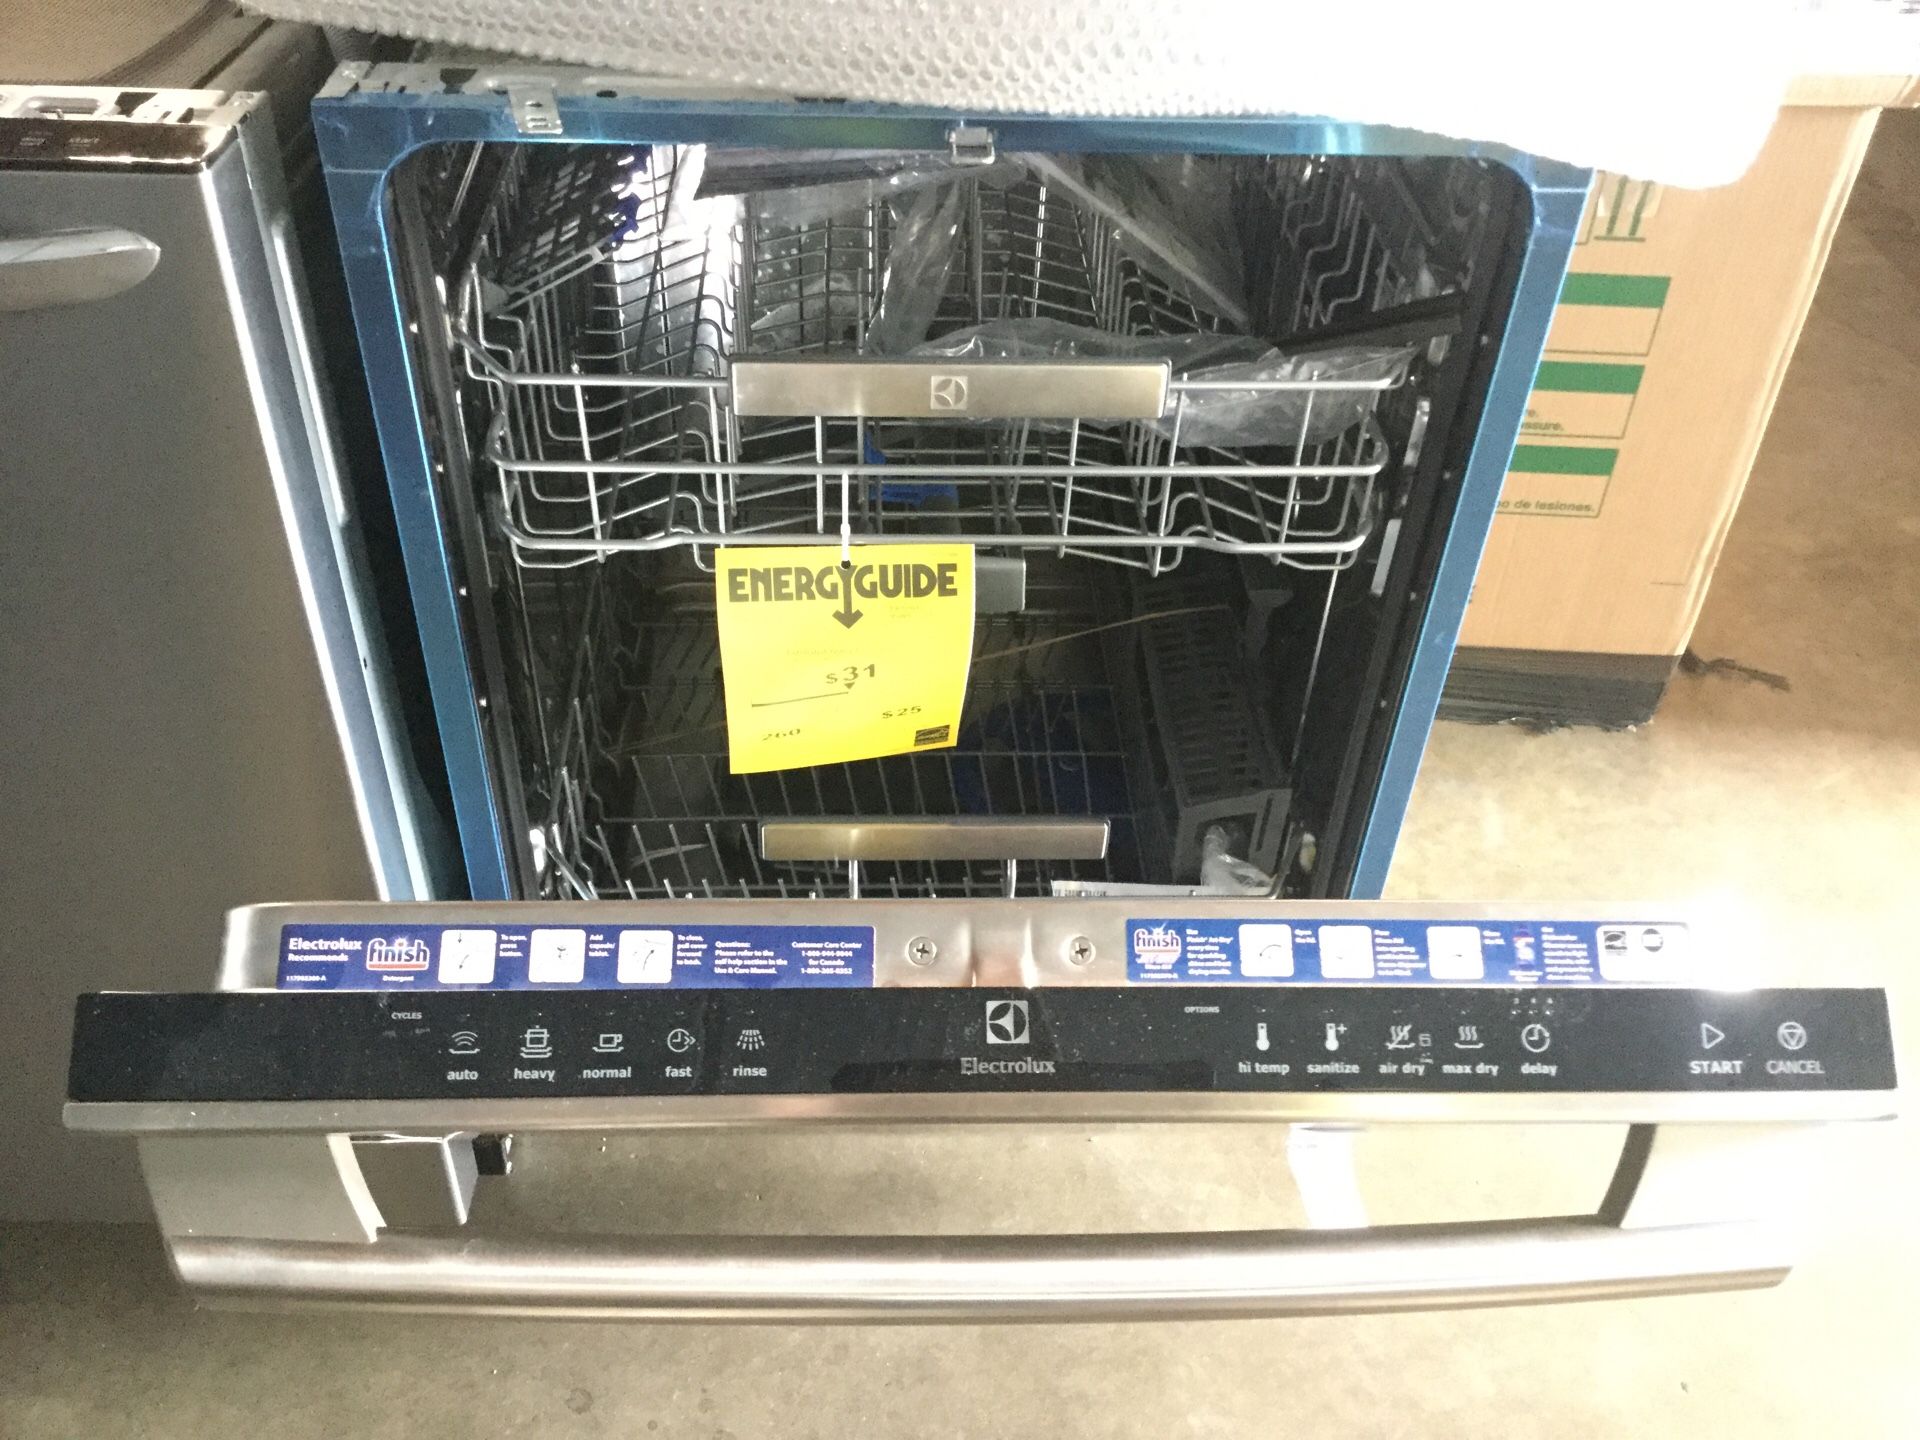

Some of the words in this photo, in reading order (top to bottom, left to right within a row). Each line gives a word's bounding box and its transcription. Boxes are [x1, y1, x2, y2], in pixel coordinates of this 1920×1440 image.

[1514, 500, 1532, 509] de
[1535, 500, 1595, 512] lesiones.
[826, 663, 876, 685] $31
[882, 705, 923, 719] $25
[288, 937, 362, 950] Electrolux
[1135, 929, 1180, 947] finish
[288, 953, 349, 961] Recommends
[368, 939, 428, 963] finish
[391, 1011, 422, 1019] CYCLES
[582, 1066, 632, 1079] normal
[665, 1066, 692, 1078] fast
[733, 1065, 767, 1077] rinse
[960, 1057, 1056, 1075] Electrolux
[1238, 1062, 1252, 1073] hi
[1254, 1062, 1290, 1075] temp
[1306, 1062, 1360, 1074] sanitize
[1379, 1062, 1399, 1074] air
[1402, 1062, 1425, 1076] dry
[1441, 1064, 1473, 1074] max
[1475, 1062, 1499, 1077] dry
[1520, 1062, 1558, 1076] delay
[1689, 1060, 1743, 1074] START
[1765, 1060, 1825, 1074] CANCEL
[446, 1069, 479, 1080] auto
[514, 1067, 555, 1082] heavy
